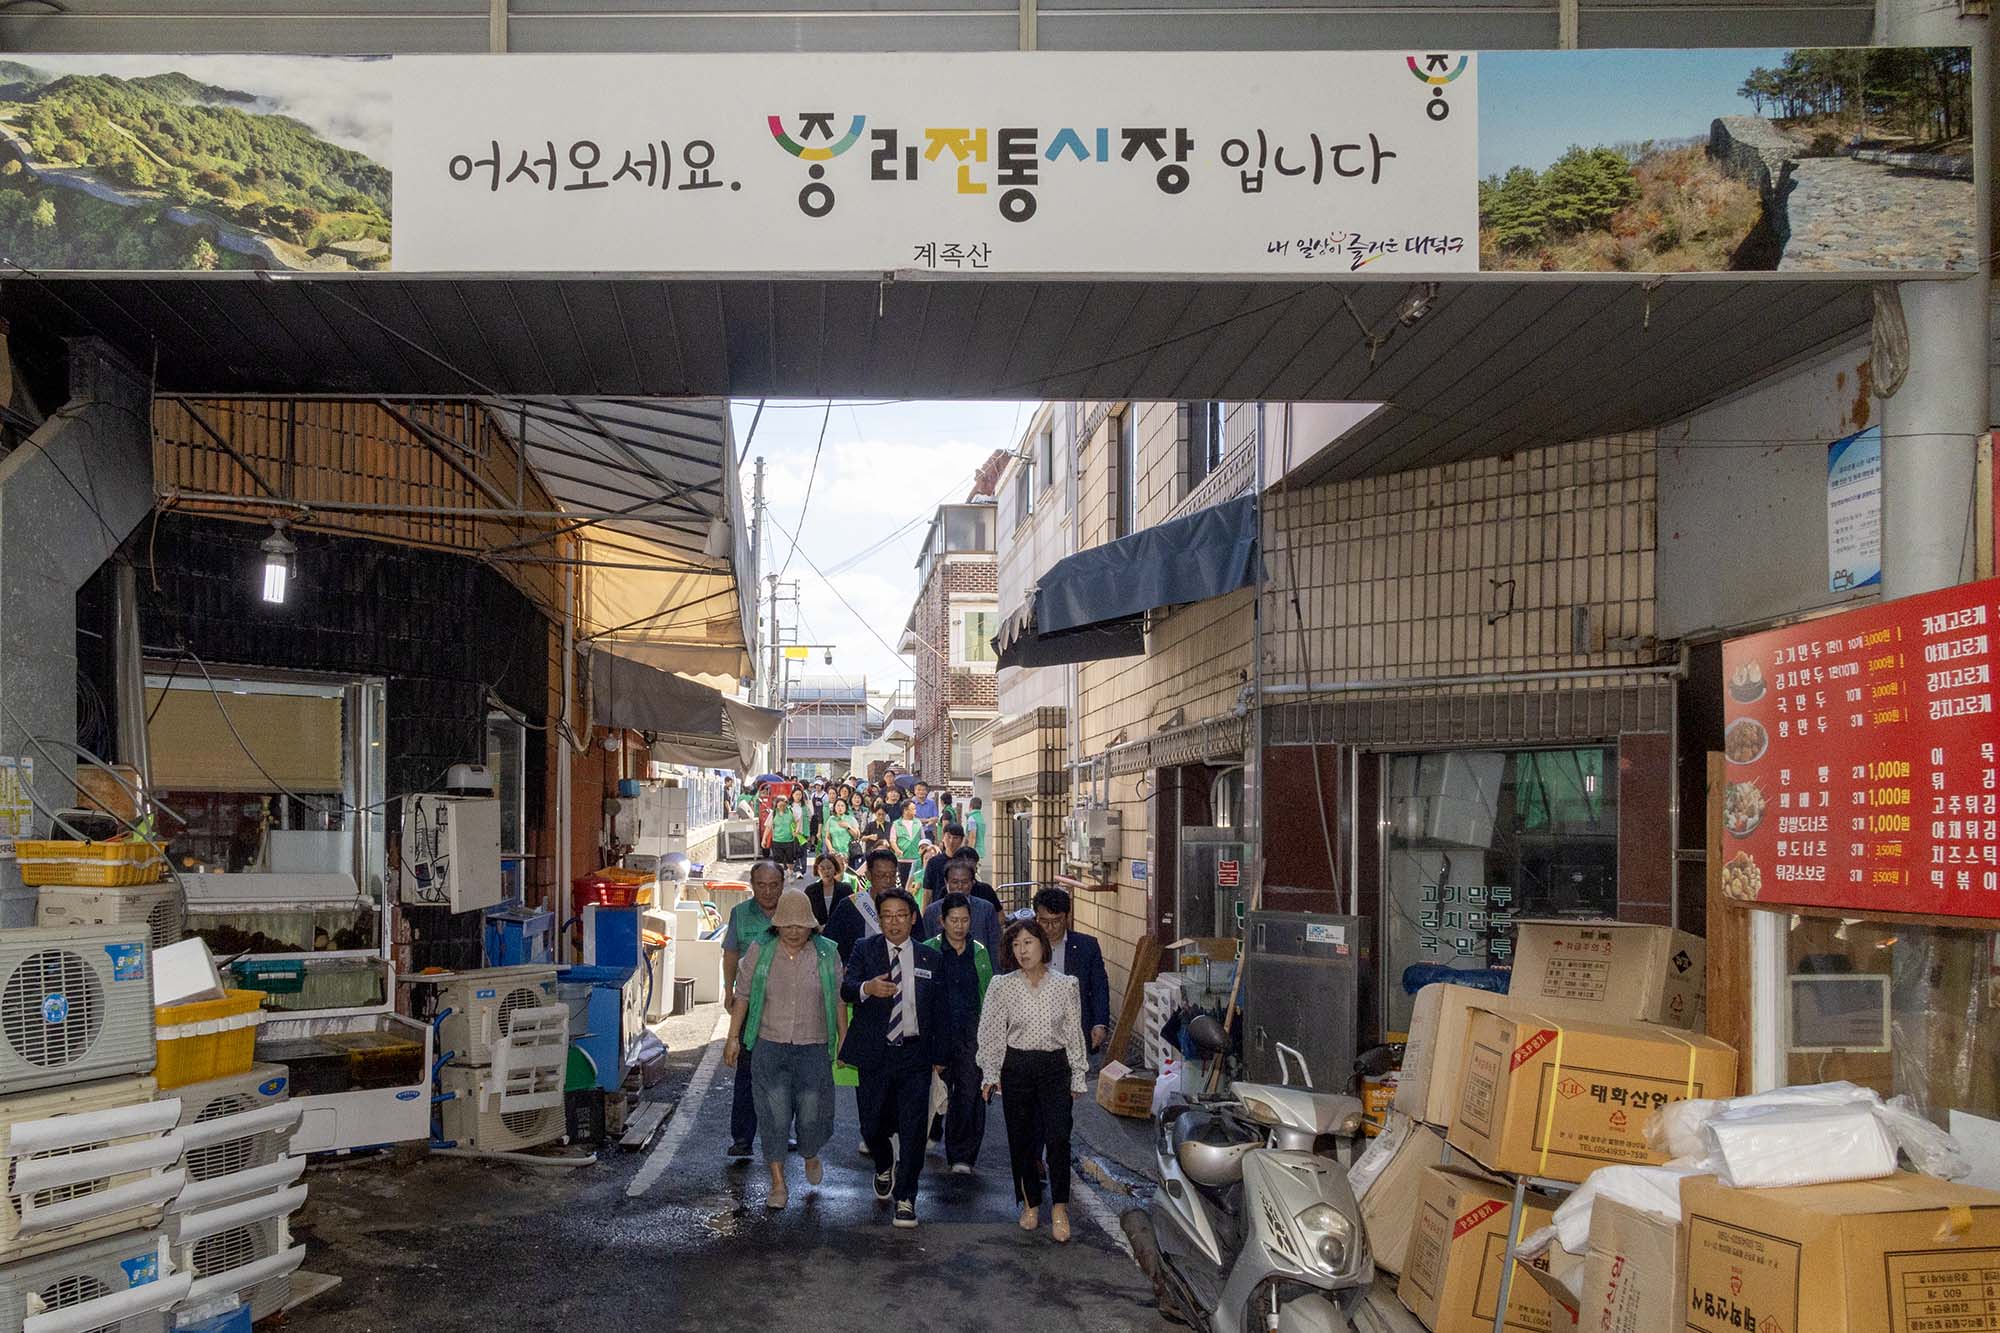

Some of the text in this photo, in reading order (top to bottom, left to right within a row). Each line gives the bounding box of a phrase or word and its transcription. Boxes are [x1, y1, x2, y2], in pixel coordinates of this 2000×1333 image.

[449, 113, 1397, 223] 어서오세요. 중리전통시장 입니다
[914, 242, 992, 268] 계족산
[1267, 233, 1464, 272] 내 일상이 즐거운 대덕구
[1774, 641, 1822, 665] 고기만두
[1924, 634, 1988, 663] 야채고로케
[1776, 666, 1824, 690] 김치만두
[1926, 663, 1990, 693] 감자고로케
[1928, 693, 1992, 721] 김치고로케
[1868, 761, 1910, 781] 1,000원
[1868, 788, 1910, 808] 1,000원
[1932, 794, 1996, 815] 고추튀김
[1868, 814, 1910, 834] 1,000원
[1932, 820, 1996, 841] 야채튀김
[1931, 845, 1997, 866] 치즈스틱
[1420, 884, 1512, 907] 고기만두
[1420, 910, 1512, 933] 김치만두
[1590, 1083, 1688, 1110] 태학산업
